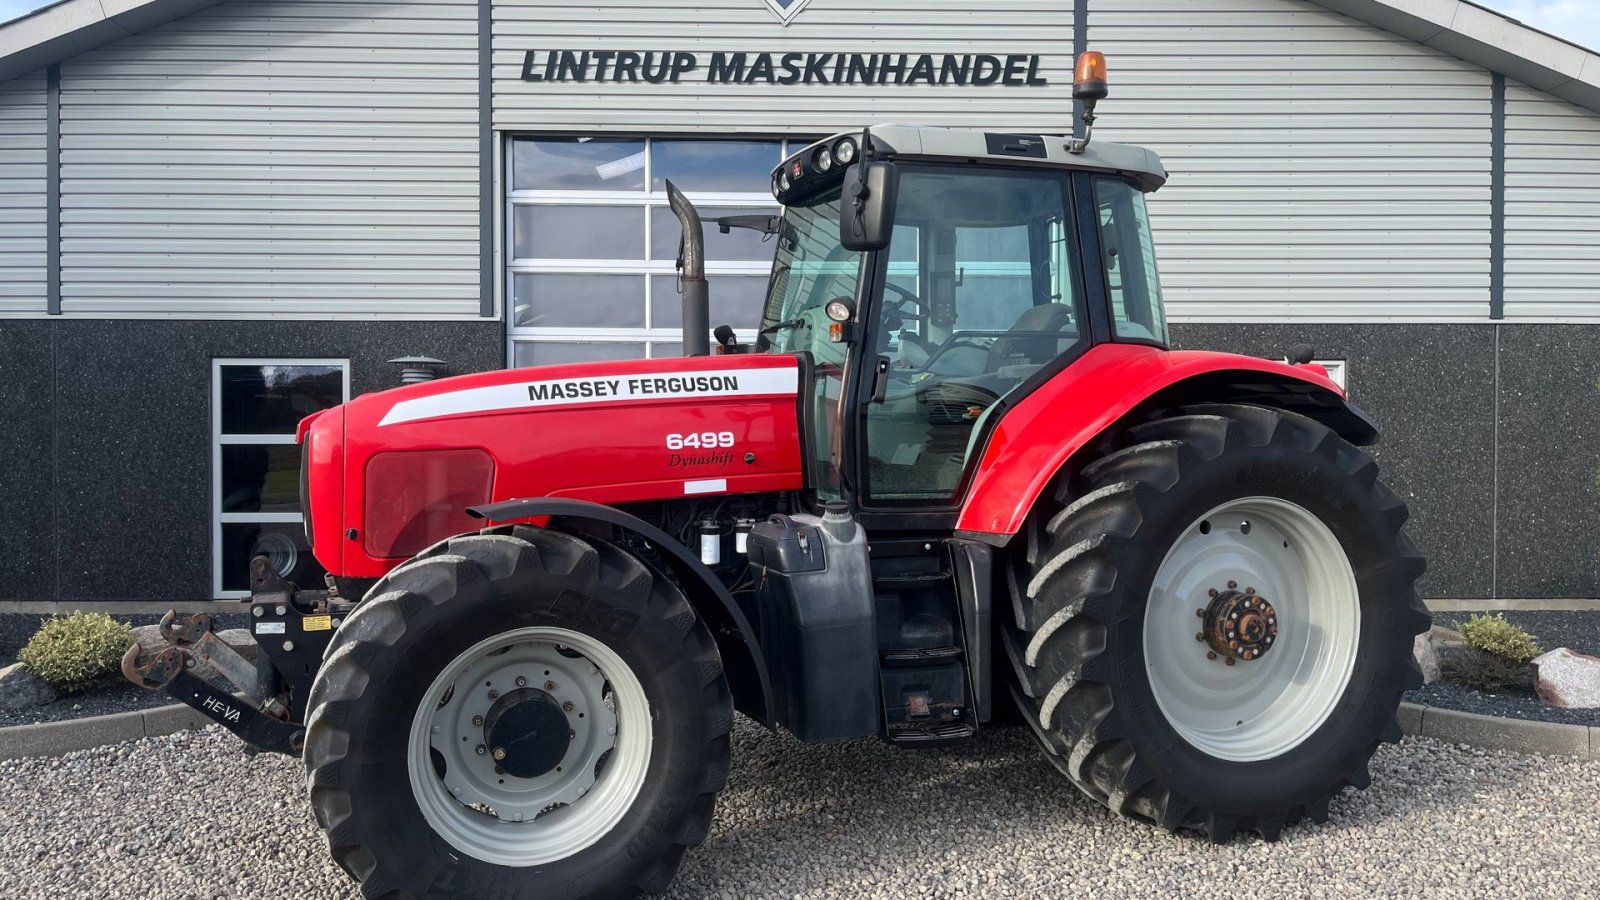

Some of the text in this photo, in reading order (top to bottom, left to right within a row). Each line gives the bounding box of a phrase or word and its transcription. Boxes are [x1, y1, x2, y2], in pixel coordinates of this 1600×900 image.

[521, 50, 1047, 86] LINTRUP MASKINHANDEL
[528, 375, 739, 400] MASSEY FERGUSON
[666, 431, 735, 450] 6499
[669, 451, 735, 470] Dynashift
